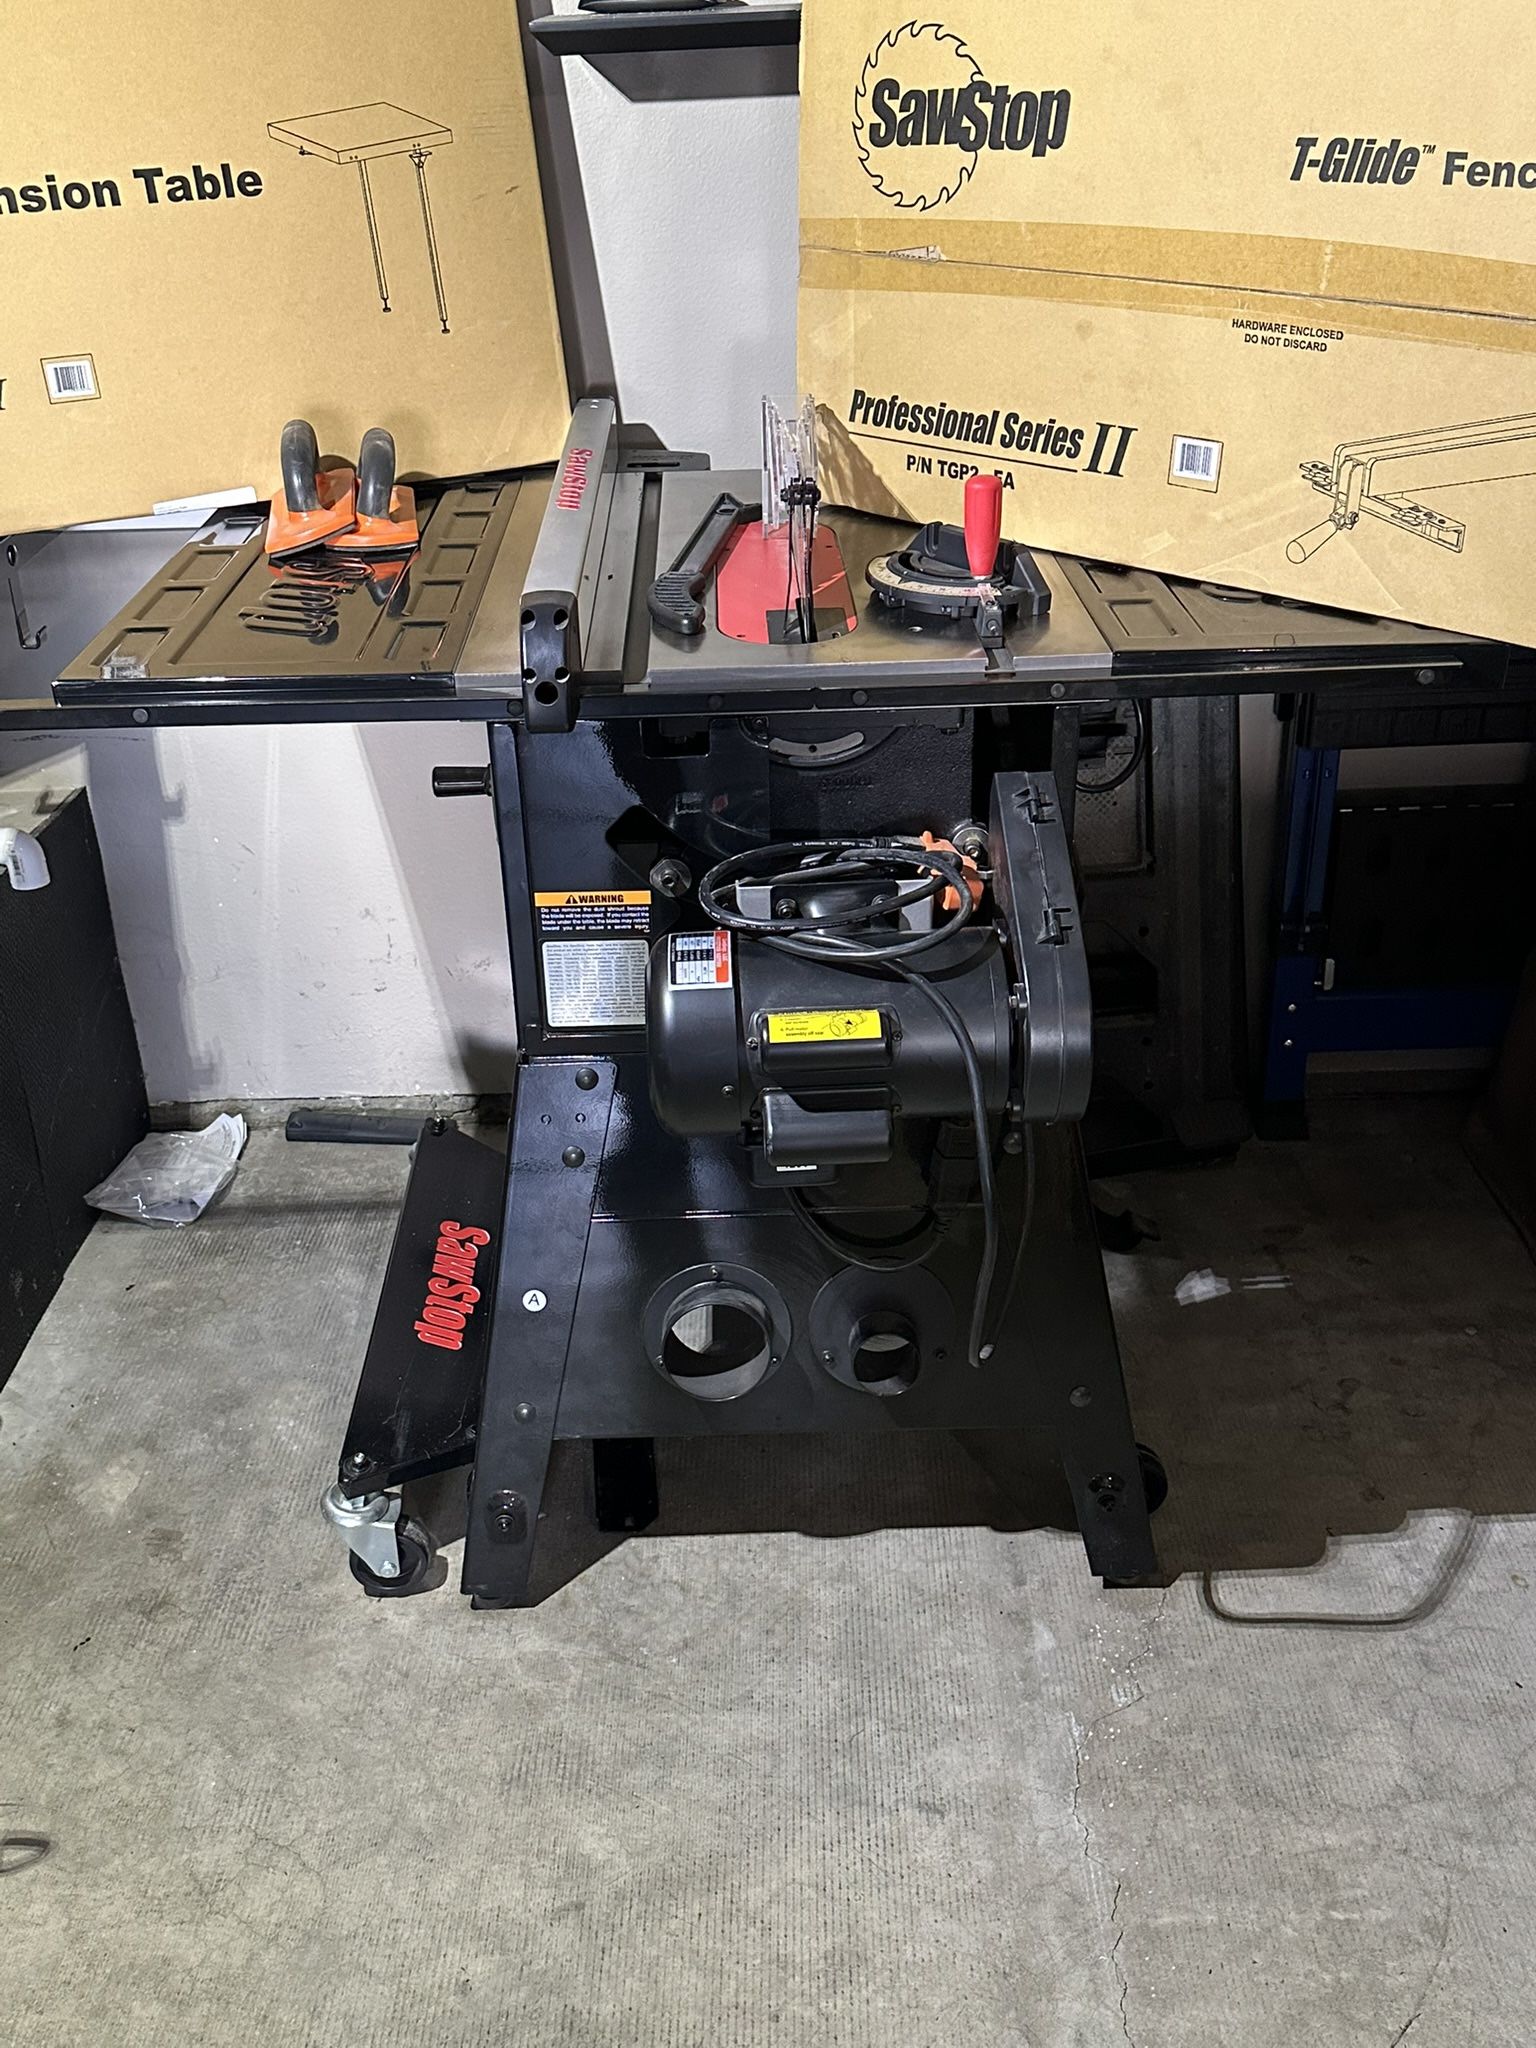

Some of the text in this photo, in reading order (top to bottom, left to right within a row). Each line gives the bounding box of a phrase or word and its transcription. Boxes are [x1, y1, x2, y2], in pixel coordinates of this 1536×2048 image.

[869, 78, 1071, 157] SawStop
[132, 163, 263, 203] Table
[1231, 318, 1344, 340] HARDWARE ENCLOSED
[1244, 333, 1327, 352] DO NOT DISCARD
[849, 389, 1139, 478] Professional Series II
[555, 448, 593, 511] SawStop
[906, 455, 932, 475] P/N
[578, 894, 624, 904] WARNING
[414, 1220, 490, 1351] SawStop
[528, 1293, 540, 1306] A
